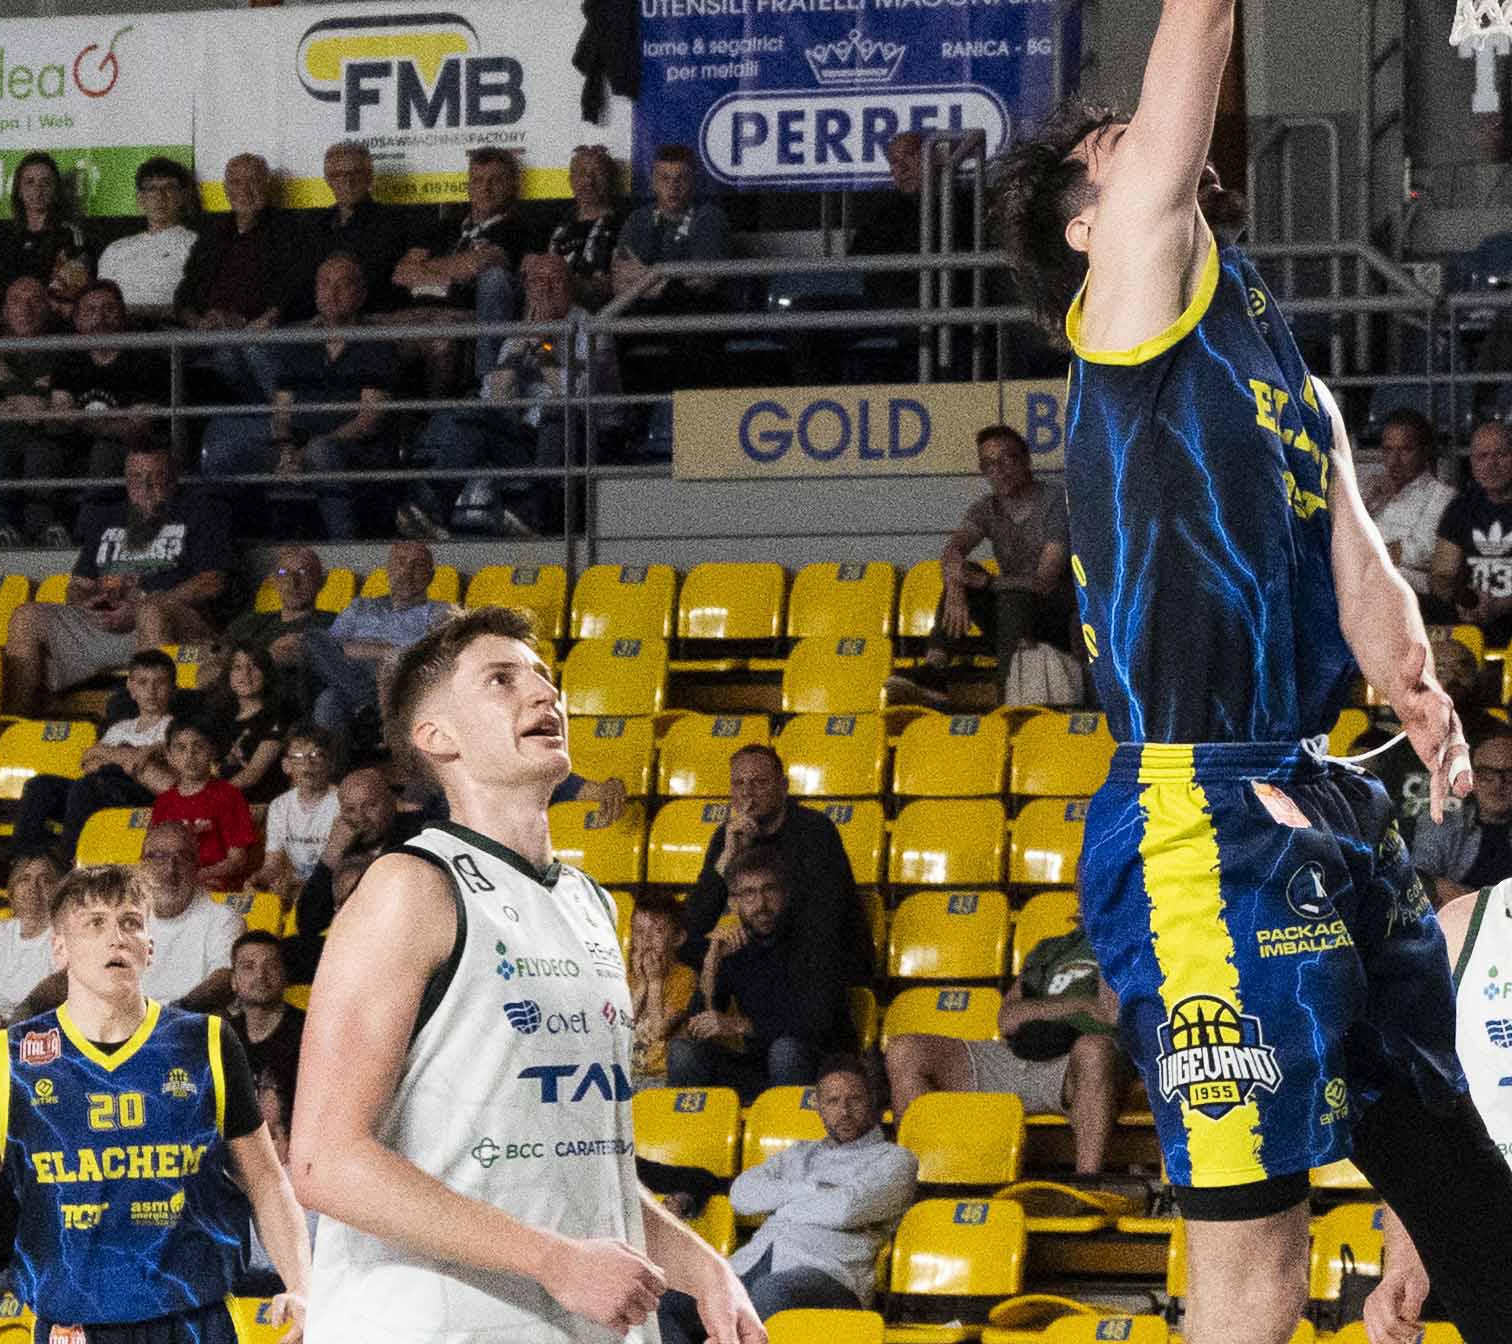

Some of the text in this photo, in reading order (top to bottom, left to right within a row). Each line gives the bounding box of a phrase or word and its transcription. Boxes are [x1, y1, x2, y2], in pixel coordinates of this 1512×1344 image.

[641, 38, 686, 58] lame
[709, 33, 786, 59] segatrici
[940, 37, 1053, 61] RANICA BG
[665, 58, 760, 84] per metalli
[344, 56, 528, 132] FMB
[39, 114, 75, 129] Web
[737, 399, 933, 463] GOLD
[517, 958, 580, 978] FLYDECO
[1194, 1083, 1233, 1100] 1955
[88, 1090, 146, 1132] 20
[506, 1143, 544, 1159] BCC
[31, 1144, 207, 1184] ELACHEM
[130, 1201, 169, 1213] asm
